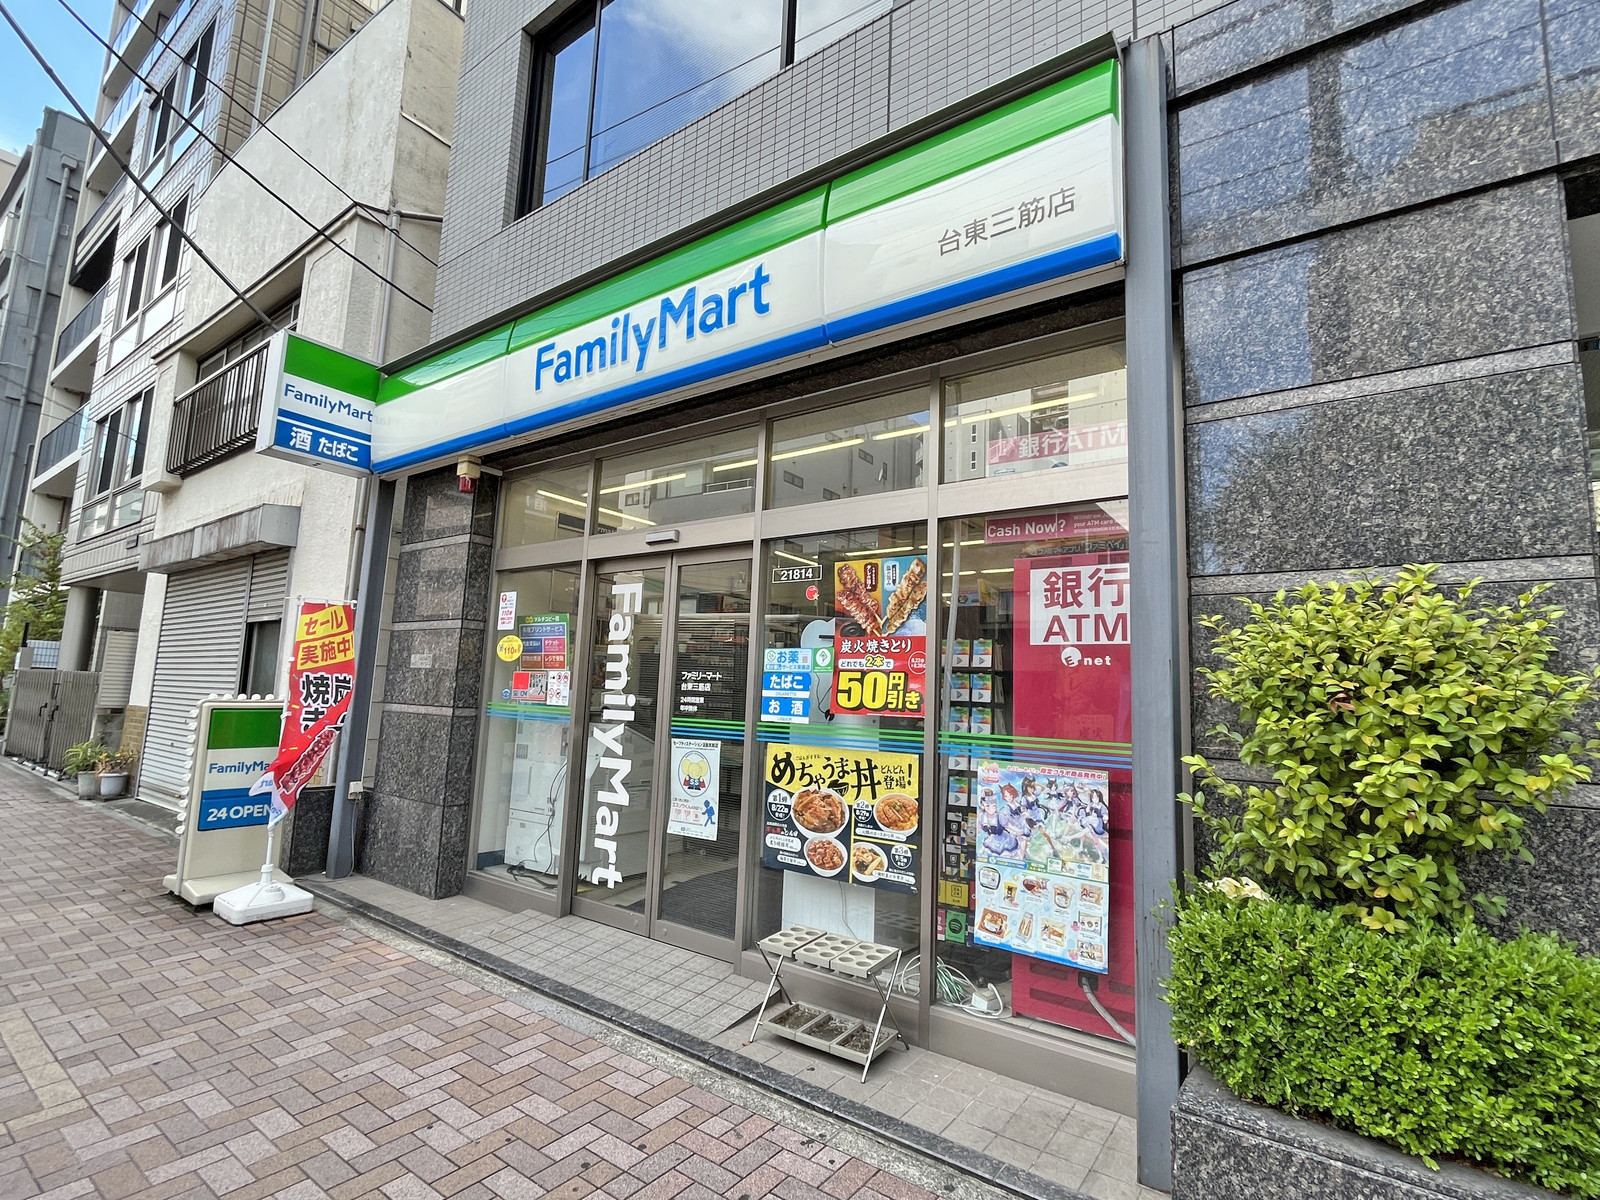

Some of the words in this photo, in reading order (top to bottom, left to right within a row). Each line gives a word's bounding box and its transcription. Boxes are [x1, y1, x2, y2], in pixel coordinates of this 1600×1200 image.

[938, 186, 1076, 256] 台東三筋店
[535, 265, 770, 391] FamilyMart
[284, 383, 373, 422] FamilyMart
[289, 427, 312, 451] 酒
[318, 437, 359, 462] たばこ
[1019, 422, 1126, 458] 銀行ATM
[987, 524, 1021, 538] Cash
[1025, 519, 1066, 535] Now?
[780, 569, 813, 580] 21814
[1043, 568, 1129, 609] 銀行
[304, 610, 343, 636] セール
[1043, 613, 1127, 642] ATM
[301, 635, 355, 666] 実施中!
[777, 650, 799, 664] お薬
[840, 639, 911, 653] 炭火焼きとり
[840, 655, 892, 668] どれでも2本で
[681, 671, 722, 681] ファミリーマート
[769, 674, 804, 689] たばこ
[837, 671, 920, 709] 50円引き
[768, 699, 804, 715] お酒
[592, 583, 643, 889] FamilyMart
[208, 761, 271, 775] FamilyMa
[771, 751, 882, 801] めちゃうま丼
[880, 765, 905, 774] どんどん
[207, 807, 228, 822] 24
